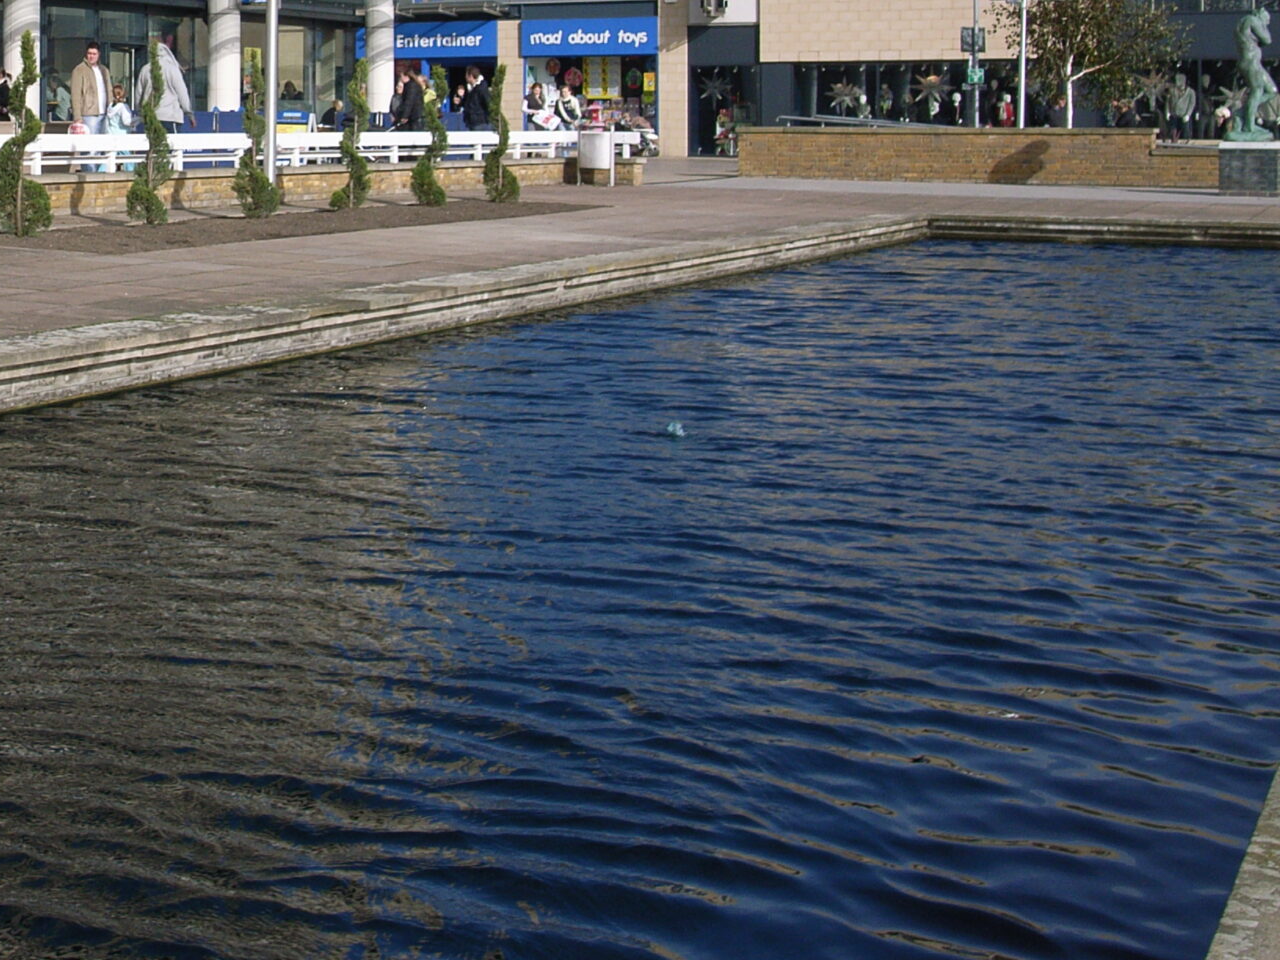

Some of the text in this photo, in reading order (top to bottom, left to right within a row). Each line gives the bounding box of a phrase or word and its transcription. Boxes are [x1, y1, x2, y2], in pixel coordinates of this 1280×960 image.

[396, 32, 483, 49] Entertainer
[530, 28, 649, 48] mad about toys
